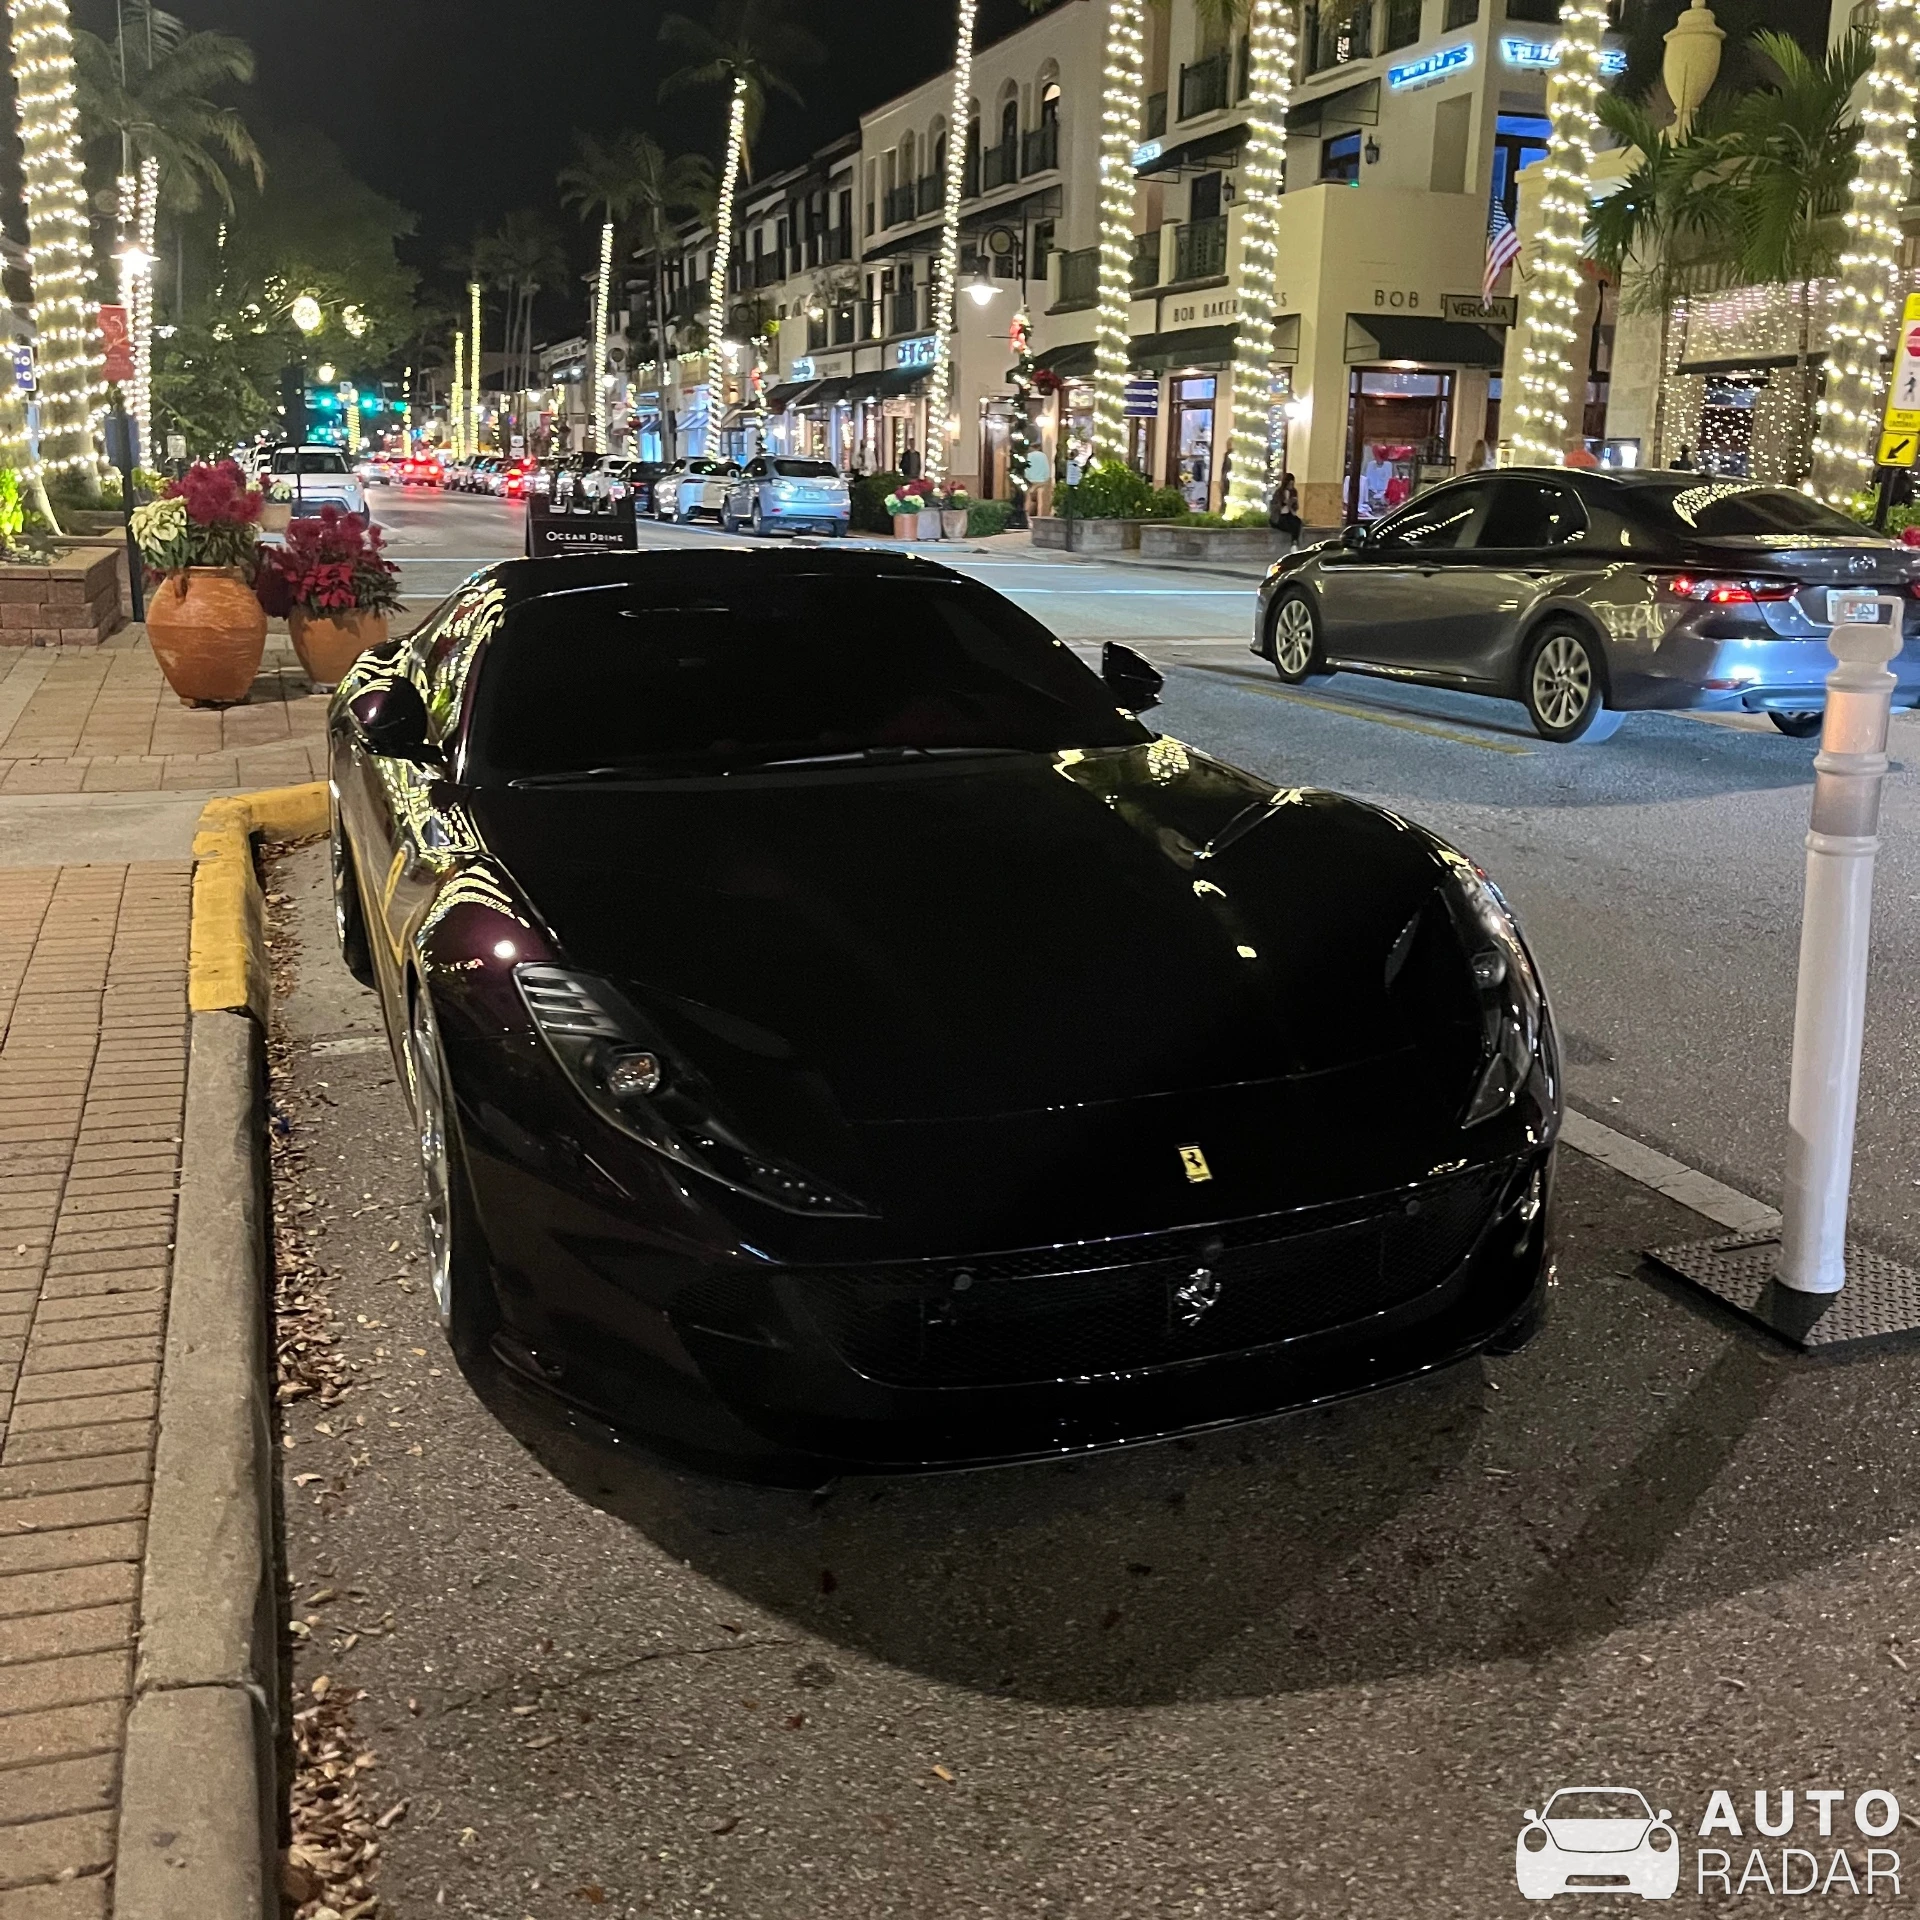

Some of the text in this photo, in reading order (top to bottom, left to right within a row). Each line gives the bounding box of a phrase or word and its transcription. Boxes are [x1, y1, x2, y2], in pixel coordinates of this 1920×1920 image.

[1374, 289, 1419, 308] BOB
[1173, 299, 1238, 322] BOB BAKER
[546, 531, 624, 542] OCEAN PRIME
